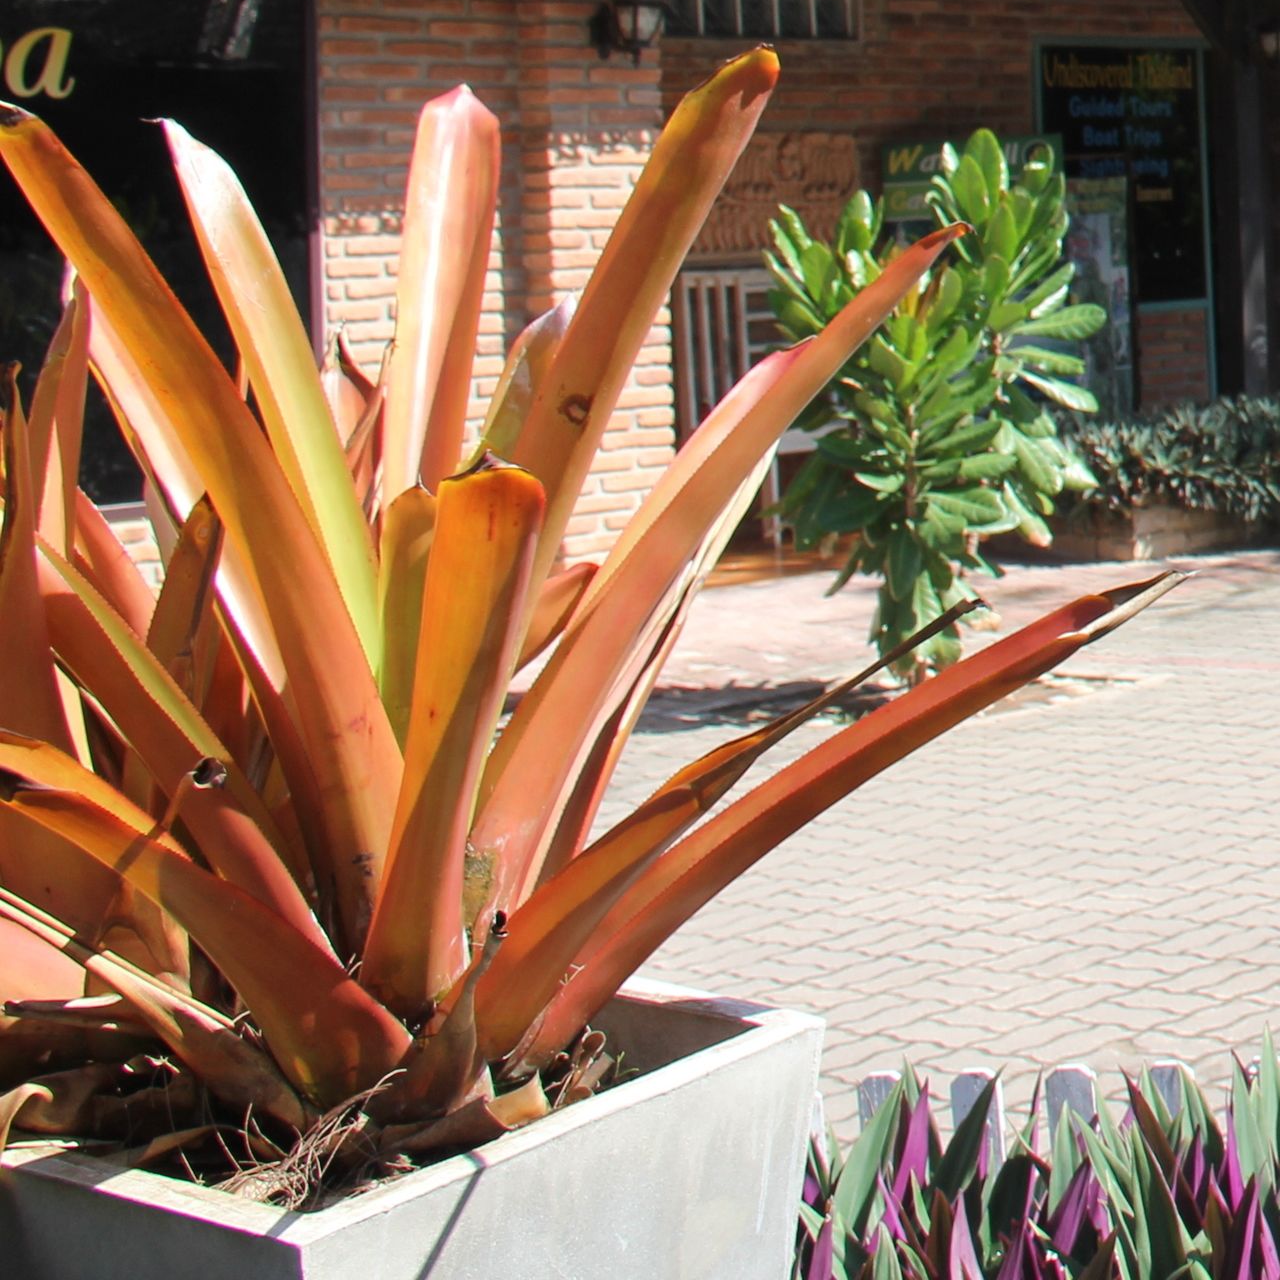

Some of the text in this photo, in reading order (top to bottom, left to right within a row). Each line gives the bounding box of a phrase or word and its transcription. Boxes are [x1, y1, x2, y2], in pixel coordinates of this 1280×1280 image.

[0, 26, 76, 100] a
[1069, 95, 1173, 117] Guided Tours
[1082, 123, 1162, 148] Boat Trips
